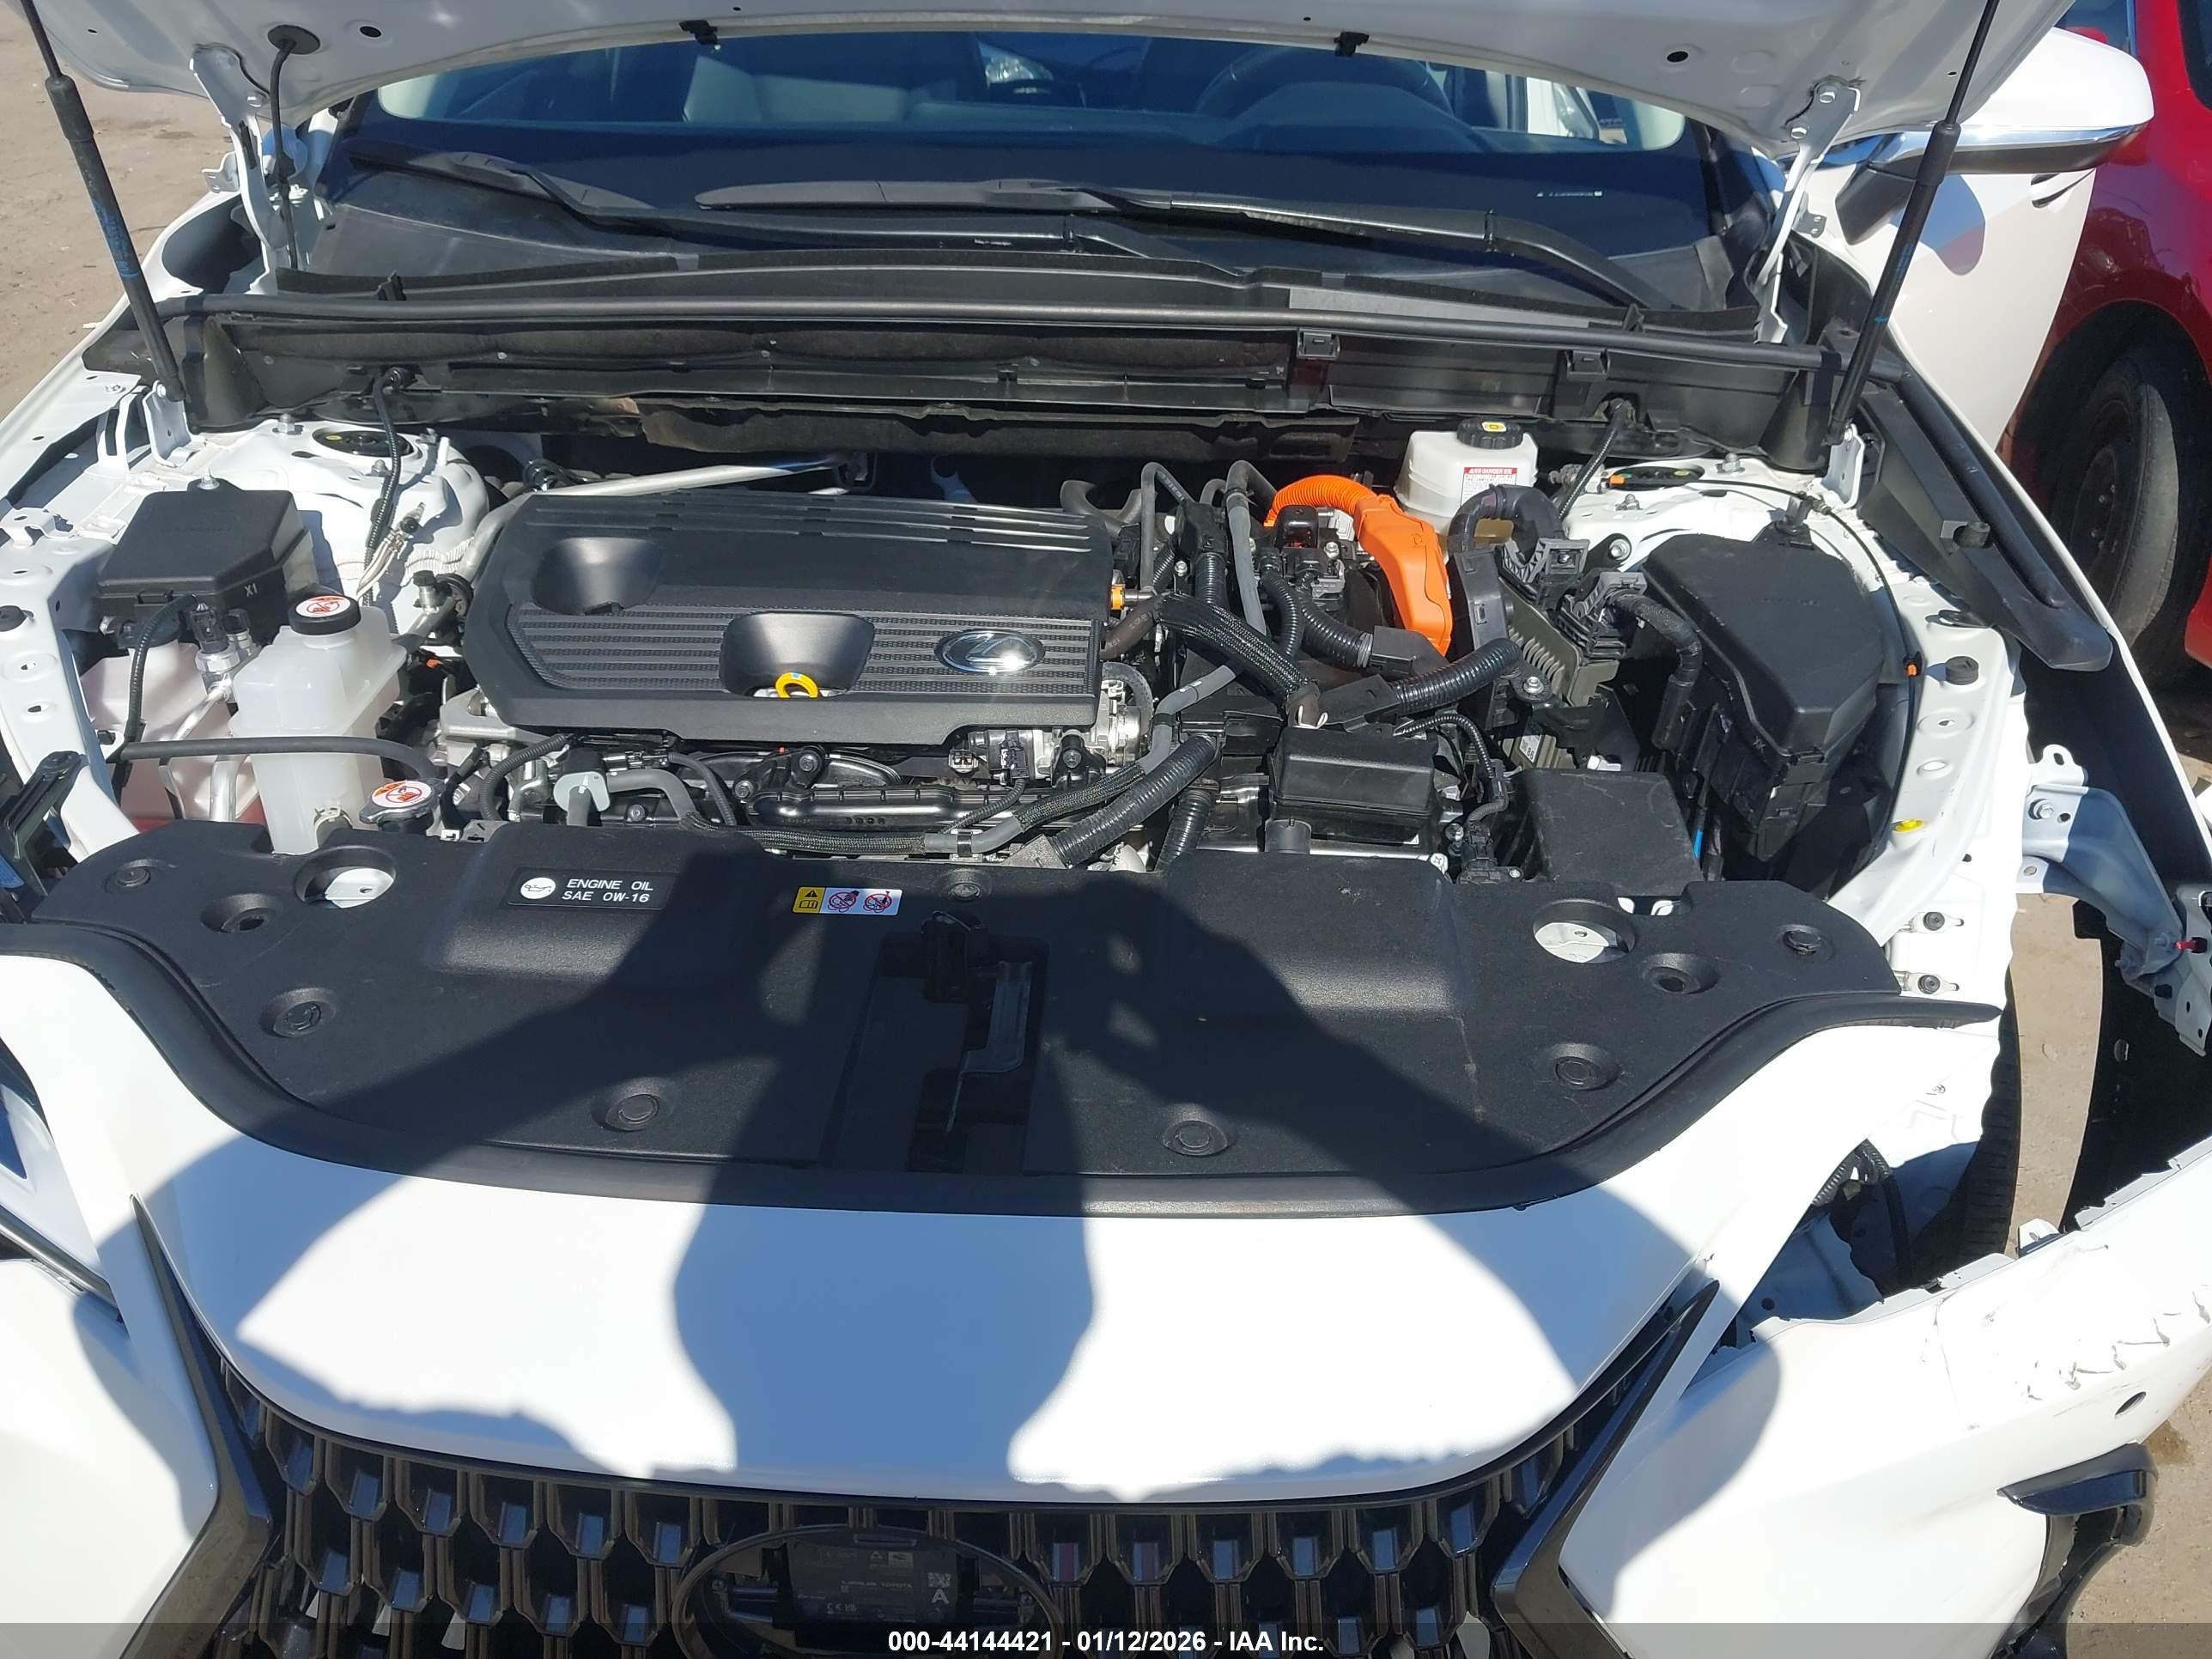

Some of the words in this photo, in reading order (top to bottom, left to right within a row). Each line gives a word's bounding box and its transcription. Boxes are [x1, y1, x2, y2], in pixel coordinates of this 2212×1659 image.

[567, 878, 623, 890] ENGINE
[631, 881, 653, 891] OIL
[562, 890, 594, 901] SAE
[603, 891, 651, 902] 0W-16
[931, 1588, 950, 1605] A
